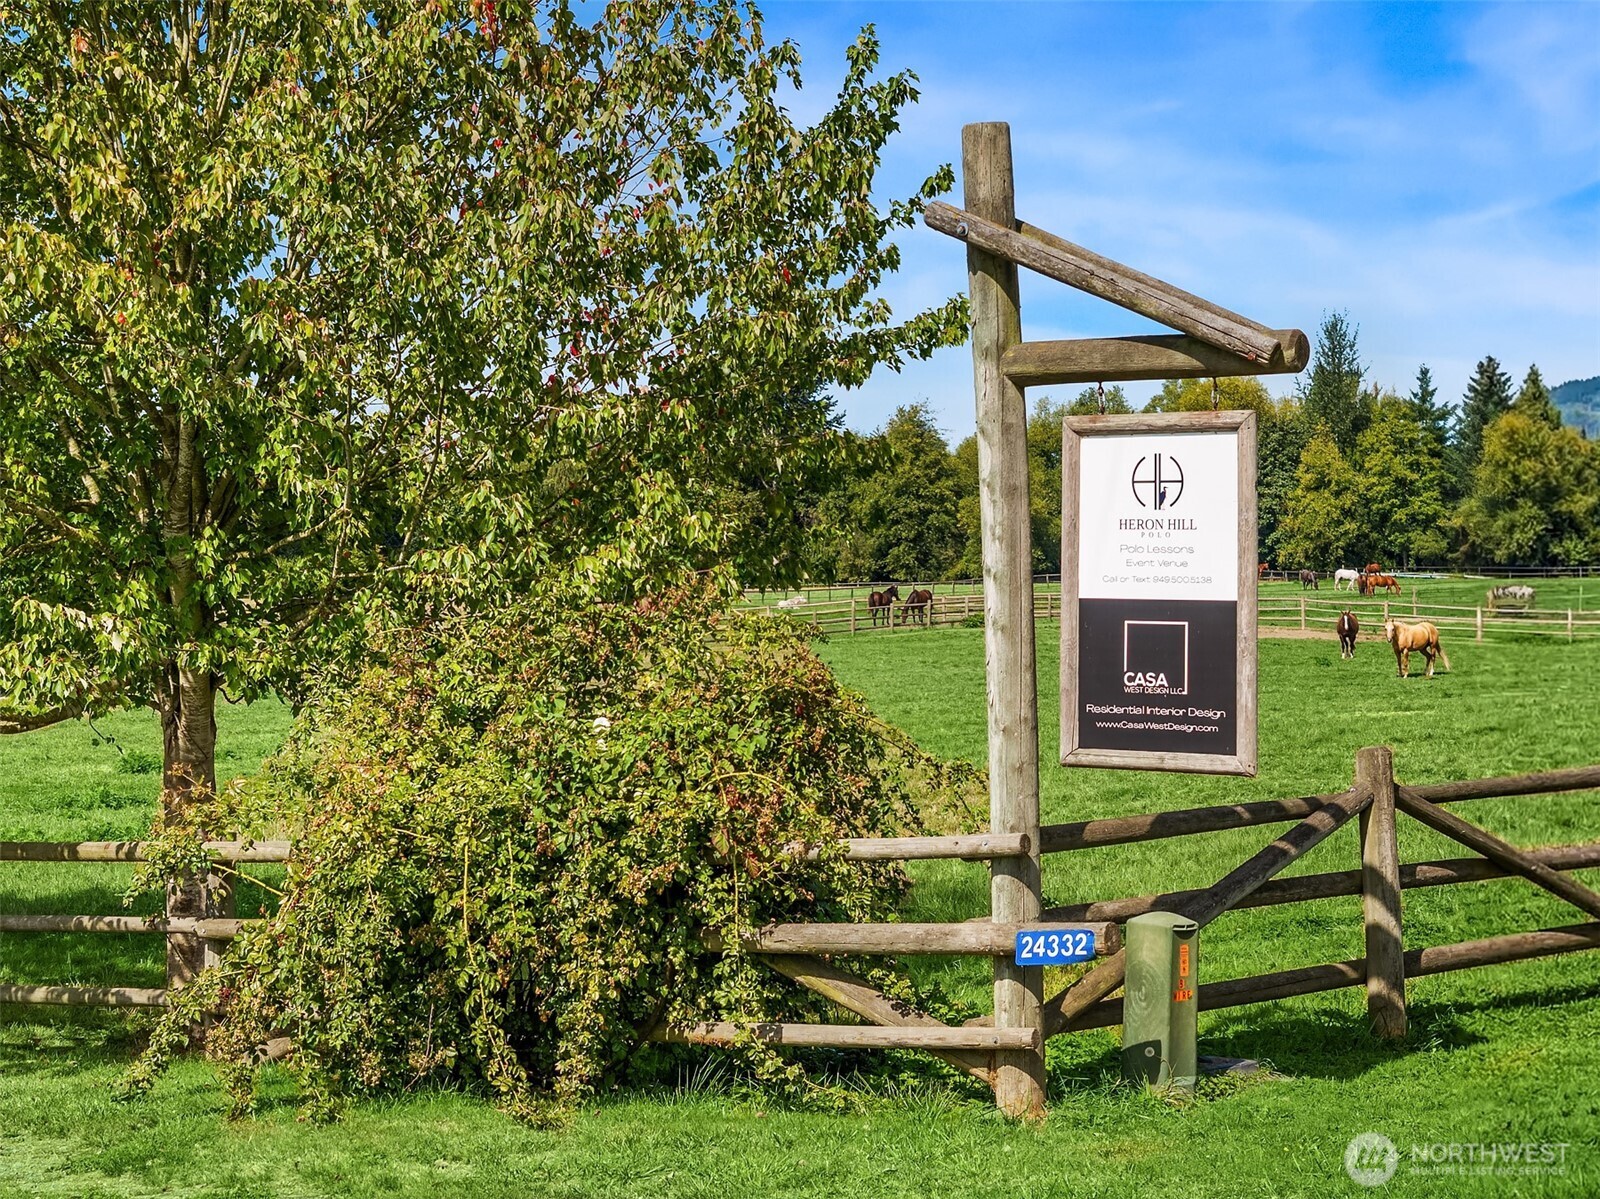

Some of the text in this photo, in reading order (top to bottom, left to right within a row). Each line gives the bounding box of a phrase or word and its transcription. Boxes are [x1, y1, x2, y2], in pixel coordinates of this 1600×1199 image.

[1119, 518, 1197, 530] HERON HILL
[1120, 544, 1195, 554] Polo Lessons
[1125, 558, 1189, 567] Event Venue
[1102, 575, 1118, 583] Call
[1123, 672, 1168, 687] CASA
[1123, 686, 1143, 694] WEST
[1170, 687, 1183, 695] LLC
[1086, 703, 1226, 720] Residential Interior Design
[1095, 720, 1219, 733] www.CasaWestDesign.com
[1020, 933, 1088, 958] 24332
